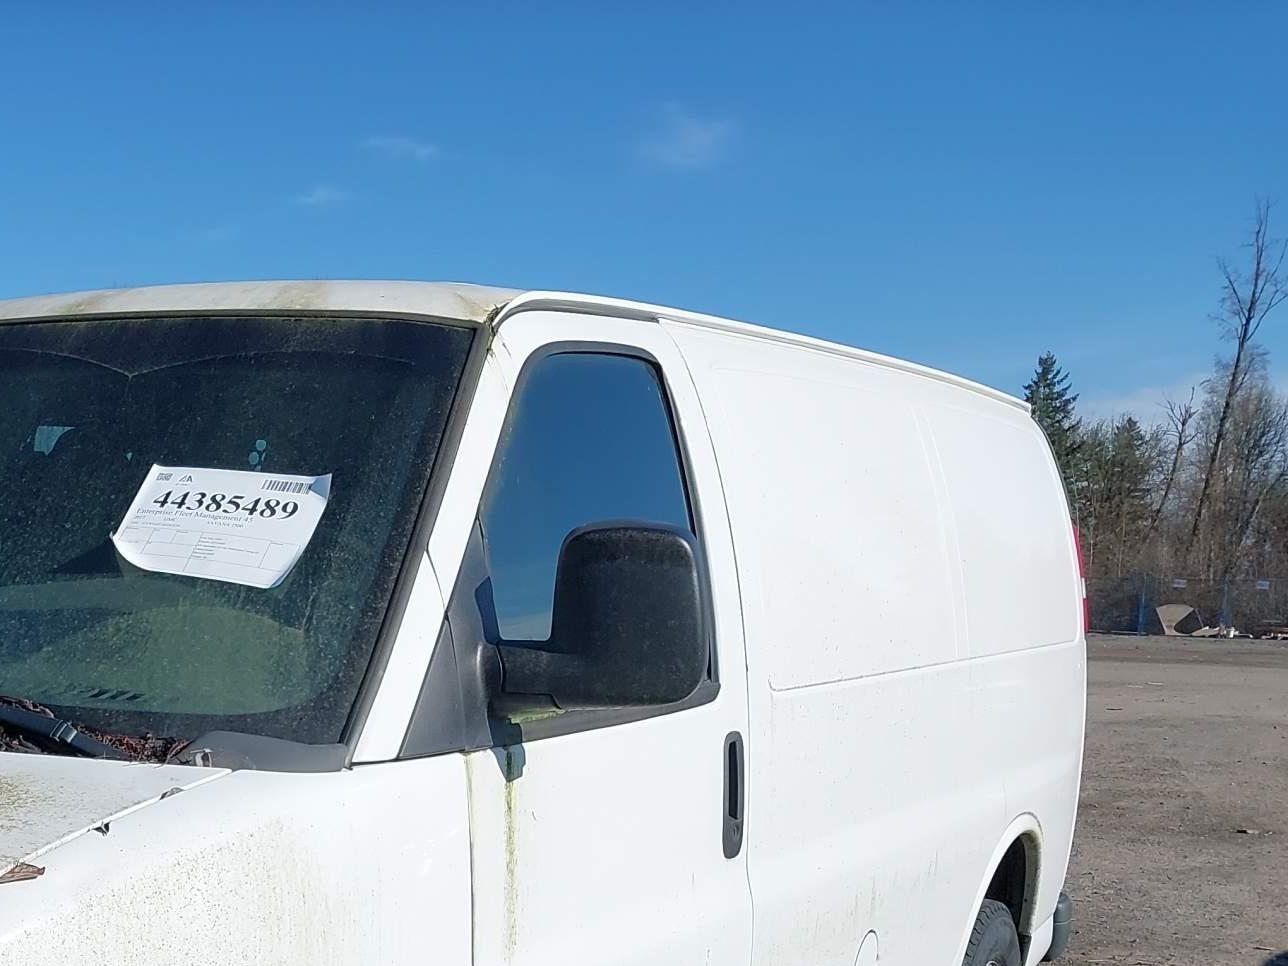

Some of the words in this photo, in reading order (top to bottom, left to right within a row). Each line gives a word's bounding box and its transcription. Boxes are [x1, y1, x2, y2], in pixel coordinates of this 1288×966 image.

[137, 508, 173, 517] Enterprise
[195, 511, 242, 522] Management
[153, 490, 299, 519] 44385489
